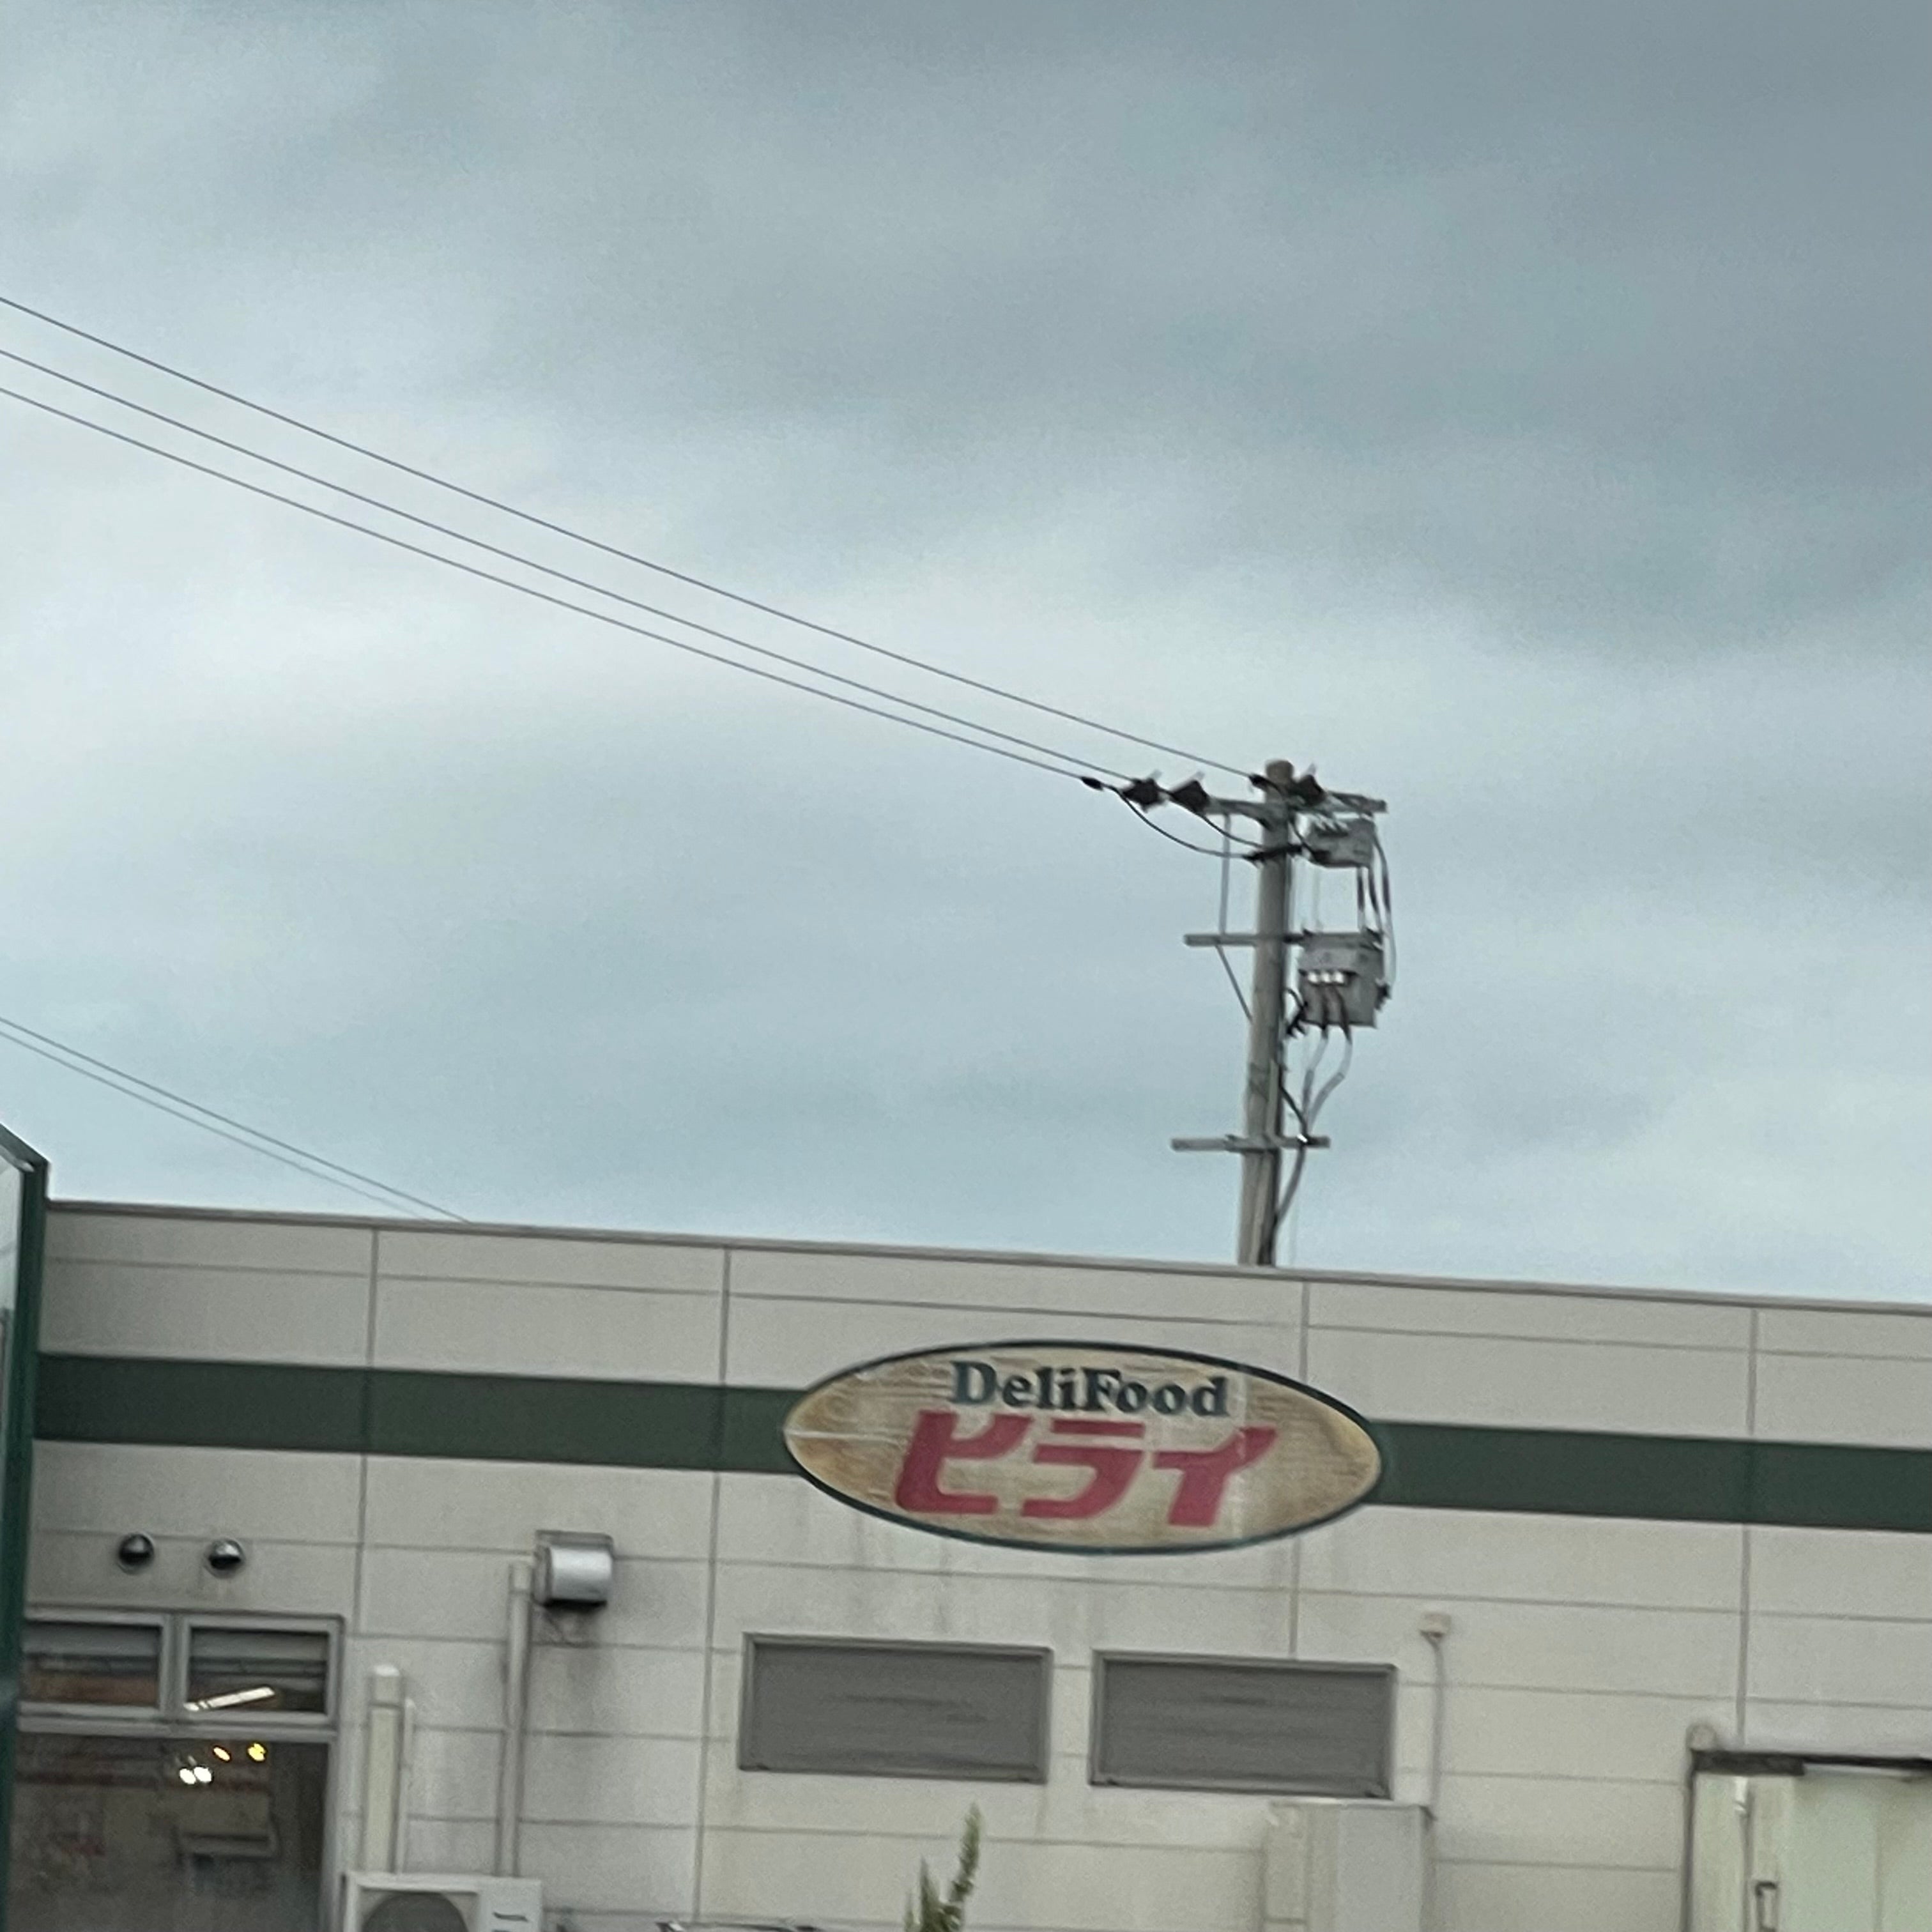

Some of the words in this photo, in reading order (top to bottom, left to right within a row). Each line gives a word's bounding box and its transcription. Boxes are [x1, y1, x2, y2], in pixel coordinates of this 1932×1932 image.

[951, 1360, 1229, 1418] DeliFood
[894, 1411, 1277, 1527] ヒライ
